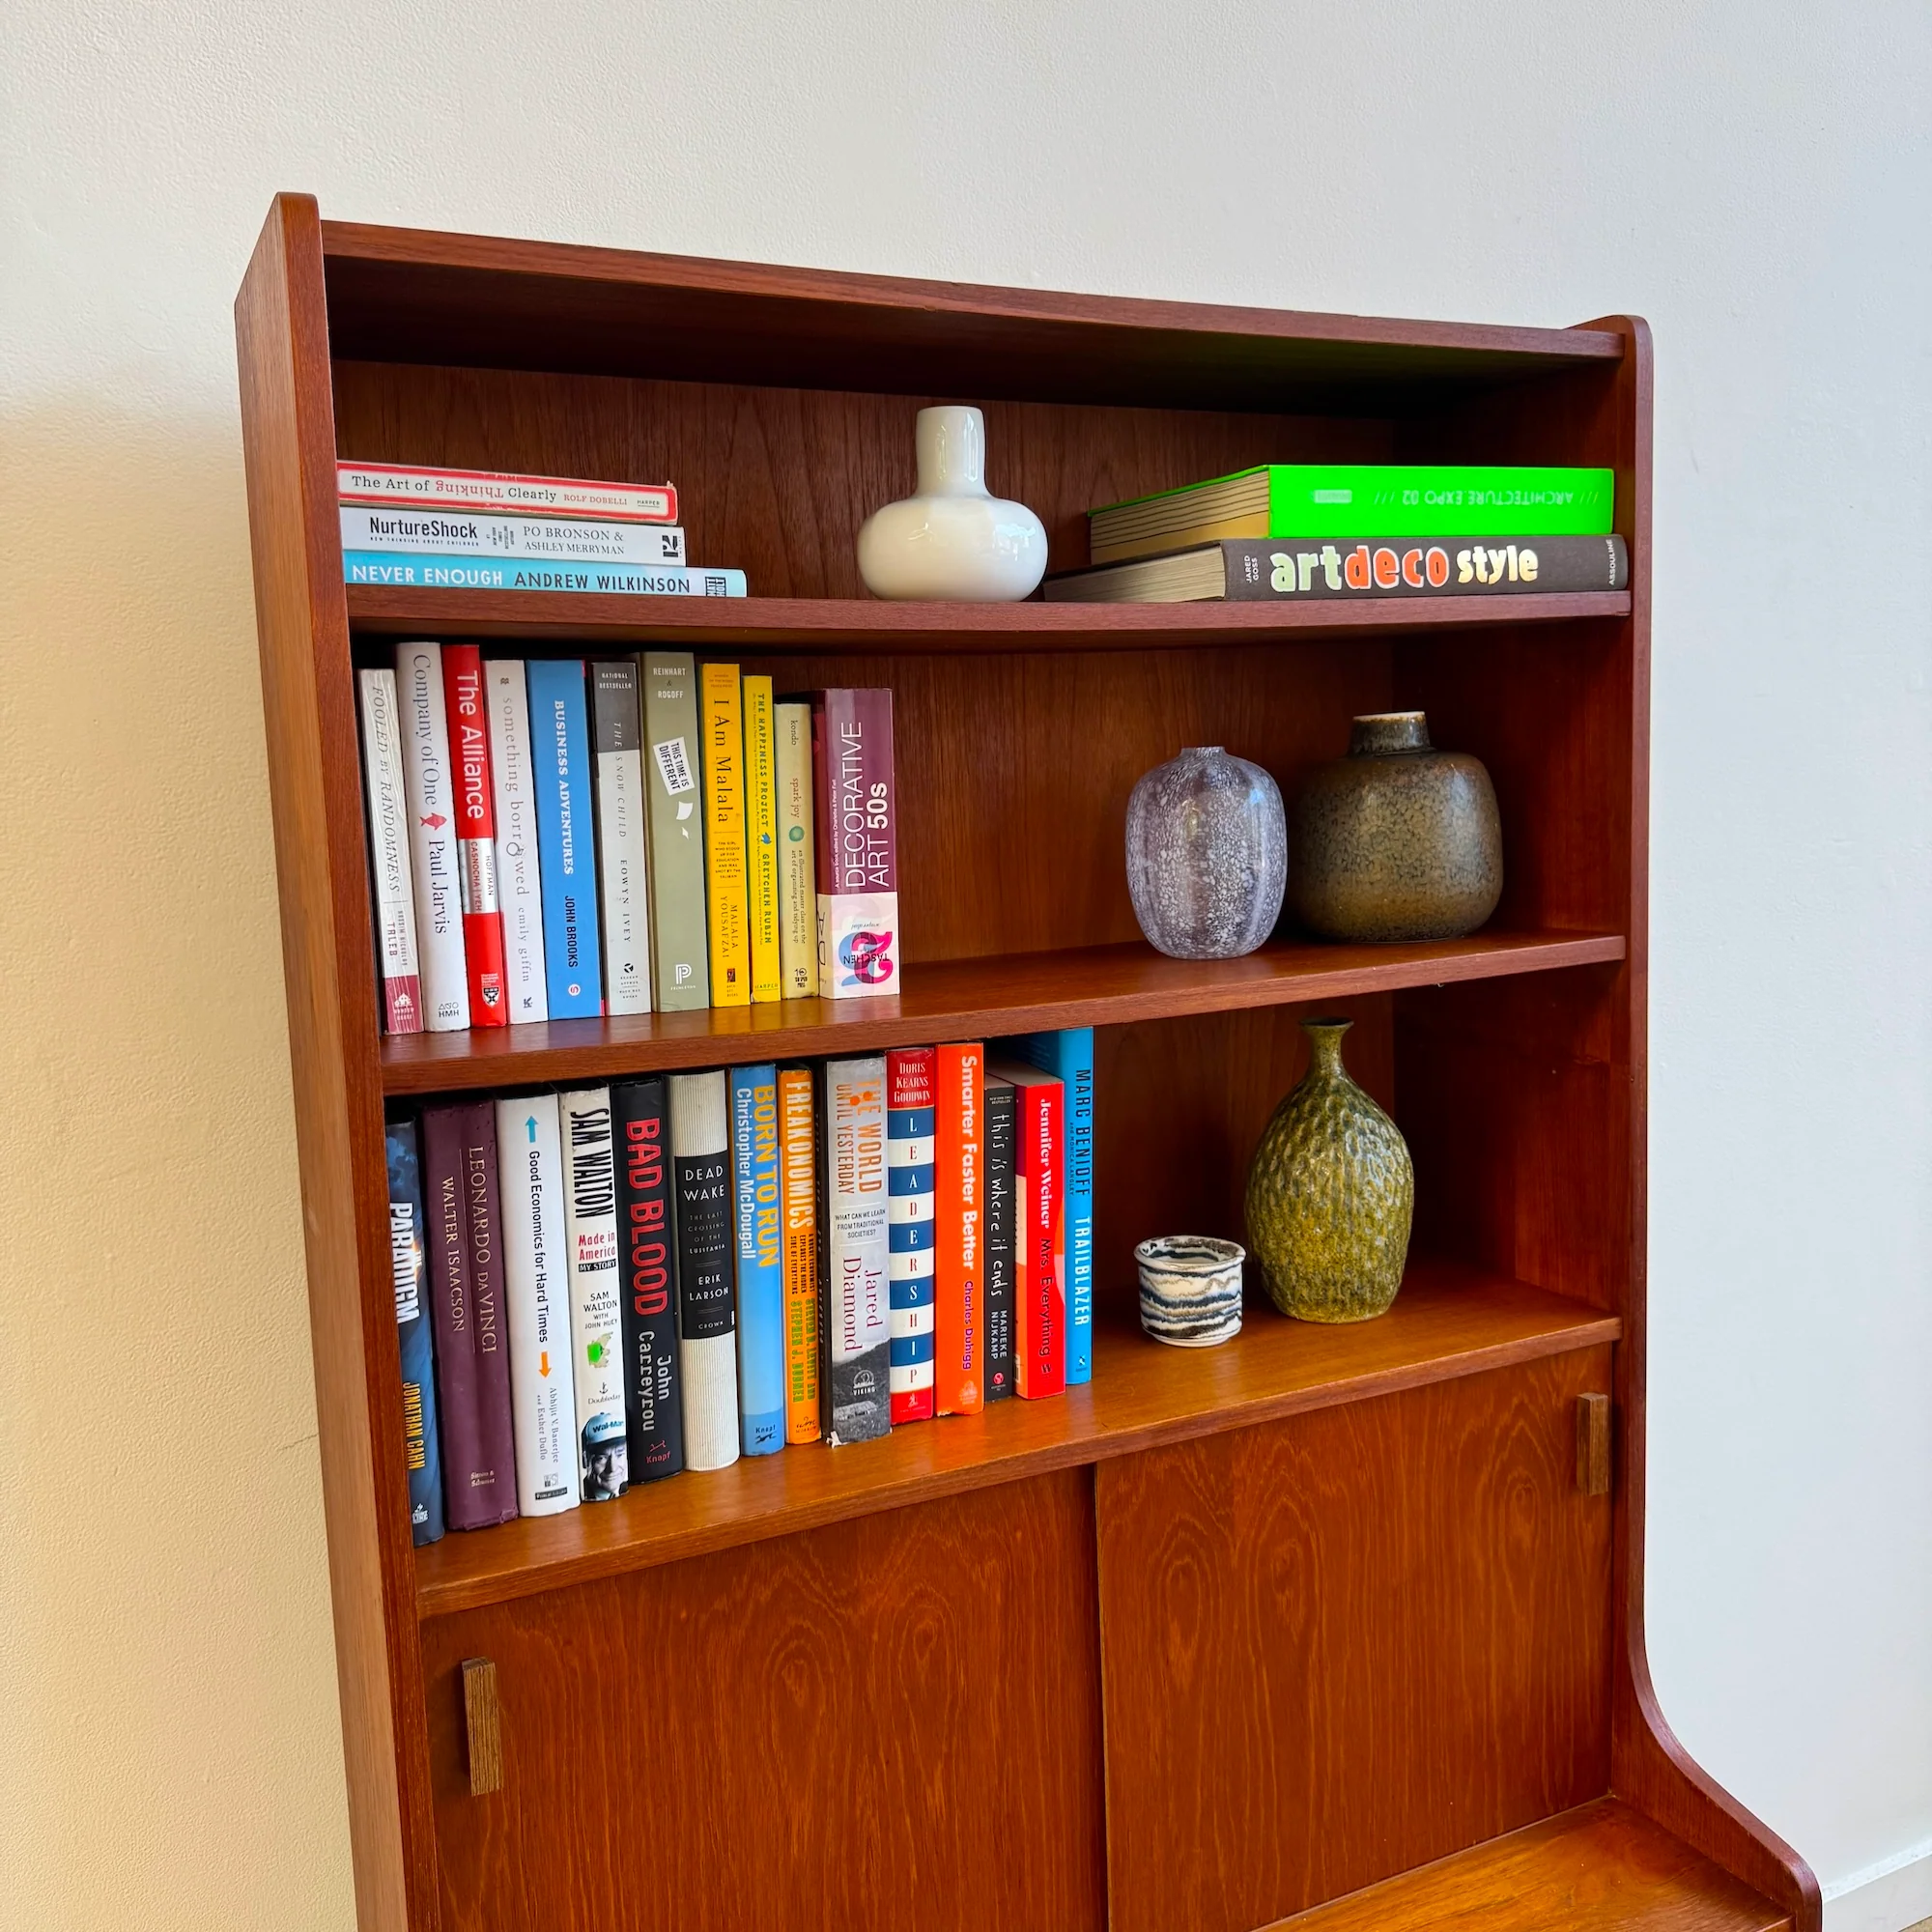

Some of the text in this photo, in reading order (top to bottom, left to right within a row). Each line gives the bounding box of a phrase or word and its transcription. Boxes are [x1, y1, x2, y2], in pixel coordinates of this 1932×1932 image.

[352, 475, 556, 503] The Art of Thinking Clearly
[564, 494, 628, 505] ROLF DOBELLI
[370, 517, 478, 539] NurtureShock
[523, 526, 541, 537] PO
[546, 526, 610, 541] BRONSON
[613, 532, 624, 541] &
[525, 541, 624, 554] ASHLEY MERRYMAN
[353, 565, 502, 585] NEVER ENOUGH
[514, 571, 690, 593] ANDREW WILKINSON
[1243, 554, 1253, 583] JARED
[1605, 538, 1616, 586] ASSOULINE
[653, 667, 686, 676] REINHART
[658, 690, 684, 699] ROGOFF
[413, 654, 441, 806] Company of One
[457, 669, 486, 819] The Alliance
[715, 715, 731, 748] Am
[758, 718, 767, 778] HAPPINESS
[790, 720, 799, 746] kondo
[372, 686, 401, 893] FOOLED BY RANDOMNESS
[554, 699, 575, 875] BUSINESS ADVENTURES
[613, 722, 627, 838] THE SNOW CHILD
[659, 745, 681, 790] DIFFERENT
[716, 754, 734, 823] Malala
[760, 781, 769, 827] PROJECT
[790, 778, 801, 818] spark joy
[840, 722, 866, 888] DECORATIVE
[866, 781, 890, 887] ART 50s
[428, 838, 451, 934] Paul Jarvis
[470, 841, 481, 888] CASNOCHA
[485, 855, 495, 896] HOFFMAN
[762, 853, 771, 907] GRETCHEN
[620, 859, 631, 943] EOWYN IVEY
[518, 907, 532, 982] emily giffin
[564, 895, 580, 968] JOHN BROOKS
[720, 895, 729, 958] YOUSAFZAI
[730, 904, 739, 950] MALALA
[843, 952, 890, 965] TASCHEN
[439, 1009, 460, 1018] HMH
[895, 1075, 929, 1089] KEARNS
[899, 1062, 925, 1074] DORIS
[894, 1089, 931, 1103] GOODWIN
[836, 1084, 855, 1194] UNTIL YESTERDAY
[857, 1078, 882, 1194] THE WORLD
[990, 1114, 1010, 1149] this
[1075, 1068, 1092, 1196] MARC BENIOFF
[570, 1108, 614, 1219] SAM WALTON
[685, 1165, 724, 1181] DEAD
[735, 1087, 756, 1259] Christopher McDougall
[753, 1084, 780, 1267] BORN TO RUN
[786, 1080, 814, 1230] FREAKONOMICS
[961, 1055, 978, 1270] Smarter Faster Better
[991, 1158, 1008, 1170] is
[1040, 1098, 1053, 1230] Jennifer Weiner
[684, 1184, 724, 1202] WAKE
[707, 1210, 723, 1220] LAST
[990, 1178, 1009, 1232] where
[578, 1231, 615, 1247] Made in
[626, 1117, 668, 1316] BAD BLOOD
[687, 1222, 725, 1232] CROSSING
[837, 1218, 884, 1231] FROM TRADITIONAL
[847, 1229, 876, 1238] SOCIETIES?
[389, 1202, 420, 1324] PARADIGM
[441, 1176, 465, 1333] WALTER ISAACSON
[469, 1146, 497, 1354] LEONARDO DA VINCI
[528, 1151, 550, 1343] Good Economics for Hard Times
[579, 1246, 616, 1262] America
[580, 1259, 616, 1272] MY STORY
[990, 1238, 1009, 1251] it
[697, 1273, 722, 1286] ERIK
[991, 1260, 1008, 1296] ends
[1074, 1215, 1091, 1325] TRAILBLAZER
[582, 1299, 618, 1313] WALTON
[589, 1291, 611, 1301] SAM
[593, 1312, 610, 1321] WITH
[689, 1286, 729, 1302] LARSON
[842, 1256, 864, 1352] Diamond
[864, 1270, 883, 1329] Jared
[963, 1280, 974, 1325] Charles
[1038, 1238, 1054, 1357] Mrs. Everything
[584, 1318, 618, 1330] JOHN HUEY
[697, 1320, 724, 1330] CROWN
[990, 1311, 999, 1361] NIJKAMP
[999, 1309, 1008, 1358] MARIEKE
[962, 1327, 974, 1370] Duhigg
[638, 1330, 656, 1432] Carreyrou
[657, 1354, 671, 1401] John
[852, 1387, 877, 1397] VIKING
[549, 1387, 559, 1416] Abhijit
[402, 1381, 426, 1470] JONATHAN CAHN
[551, 1428, 560, 1463] Banerjee
